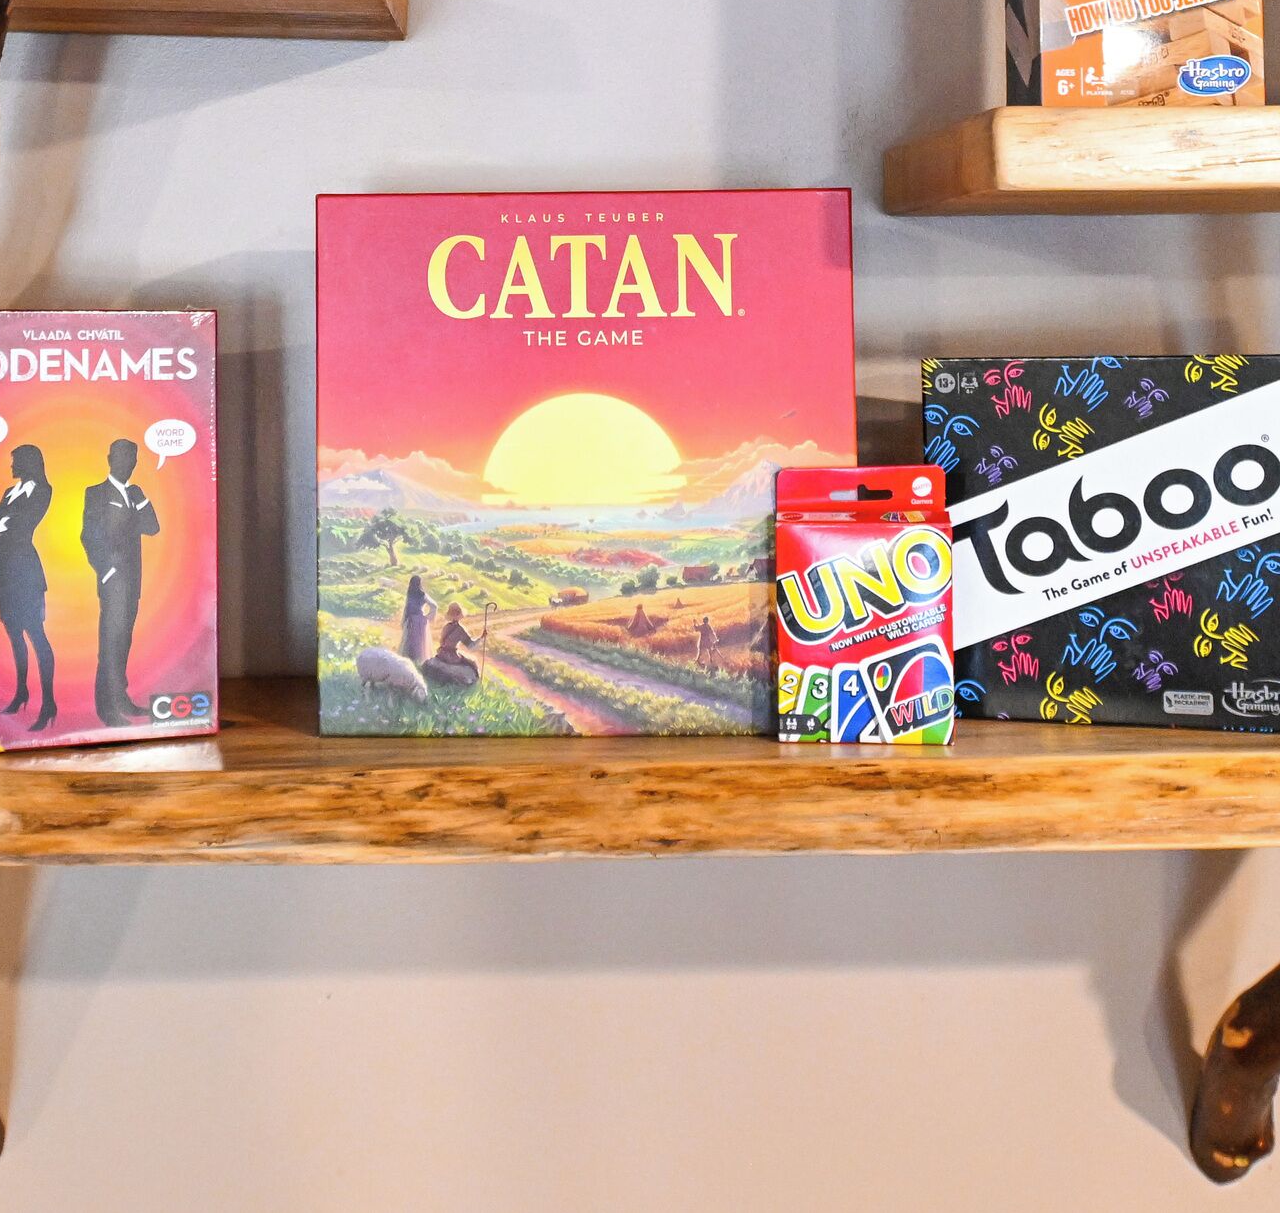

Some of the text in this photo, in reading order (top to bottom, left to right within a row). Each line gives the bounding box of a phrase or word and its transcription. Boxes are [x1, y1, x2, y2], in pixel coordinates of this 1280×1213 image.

[1068, 0, 1107, 33] HOW
[1056, 68, 1076, 77] AGES
[1182, 60, 1245, 80] Hasbro
[1057, 79, 1075, 96] 6+
[1193, 75, 1235, 91] Gaming
[500, 211, 666, 224] KLAUS TEUBER
[427, 233, 739, 320] CATAN
[23, 328, 125, 342] VLAADA CHVÁTIL
[523, 329, 644, 347] THE GAME
[938, 377, 955, 388] 13+
[155, 428, 185, 438] WORD
[156, 439, 184, 448] GAME
[1042, 508, 1275, 602] The Game of UNSPEAKABLE Fun!
[778, 527, 953, 640] UNO
[831, 604, 947, 651] NOW WITH CUSTOMIZABLE
[886, 613, 946, 640] WILD CARDS!
[780, 674, 799, 695] 2
[811, 678, 829, 699] 3
[843, 674, 860, 697] 4
[891, 688, 954, 727] WILD
[1236, 699, 1280, 716] Gaming
